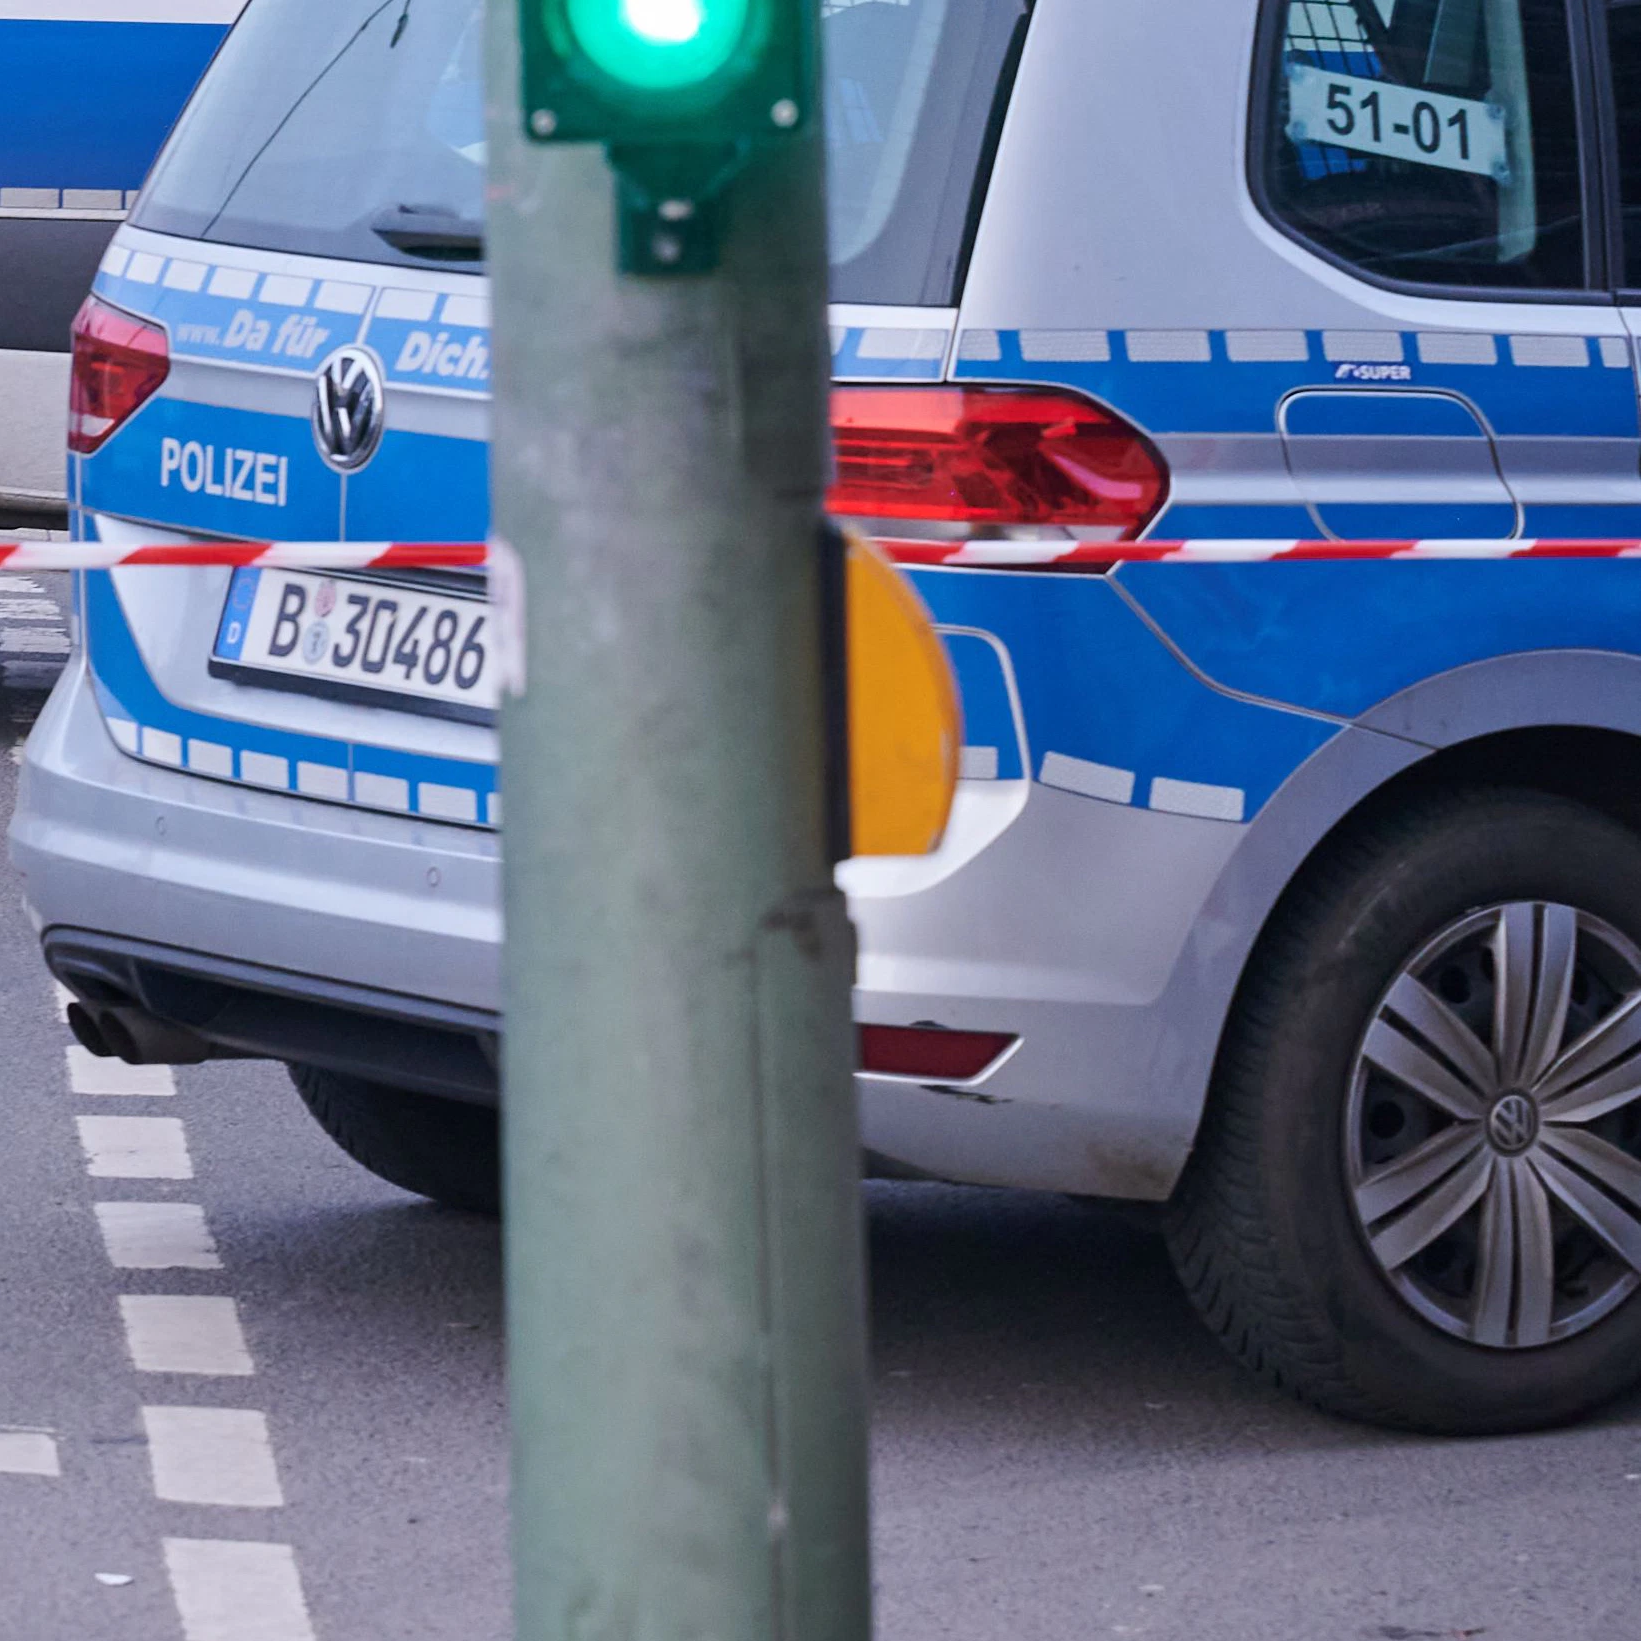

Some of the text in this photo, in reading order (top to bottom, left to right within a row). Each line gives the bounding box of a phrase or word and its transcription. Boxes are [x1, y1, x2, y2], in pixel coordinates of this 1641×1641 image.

[1326, 83, 1469, 160] 51-01
[222, 309, 271, 351] Da
[271, 313, 331, 358] für
[160, 437, 288, 507] POLIZEI
[268, 583, 307, 658] B
[331, 593, 486, 690] 30486
